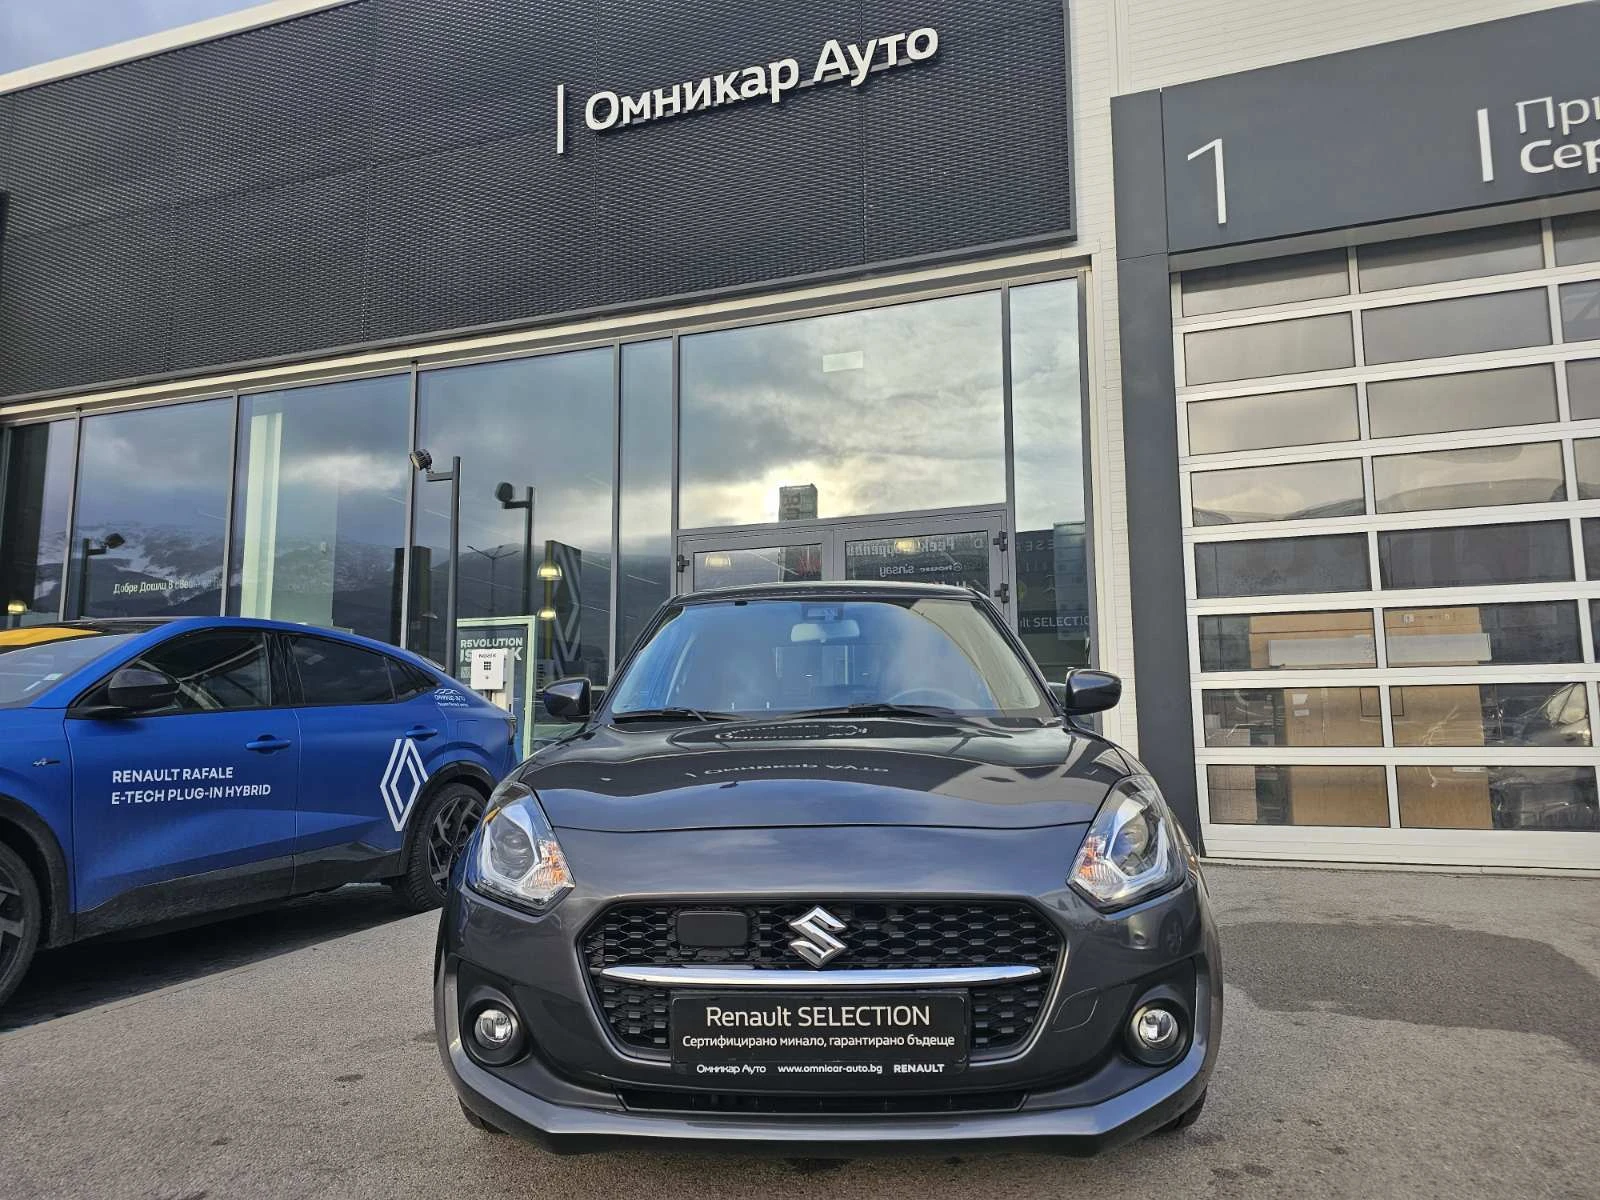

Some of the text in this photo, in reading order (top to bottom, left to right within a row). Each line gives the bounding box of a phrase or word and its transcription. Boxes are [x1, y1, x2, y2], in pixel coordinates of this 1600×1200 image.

[585, 26, 939, 131] Омникар Ауто
[1187, 138, 1227, 225] 1
[460, 637, 523, 649] R5VOLUTION
[112, 766, 234, 784] RENAULT RAFALE
[111, 784, 271, 805] E-TECH PLUG-IN HYBRID
[706, 1005, 930, 1027] Renault SELECTION
[682, 1033, 955, 1049] Сертифицирано минало, гарантирано бъдеще
[696, 1063, 945, 1075] Омникар Ауто www.omnicar-auto.bg RENAULT
